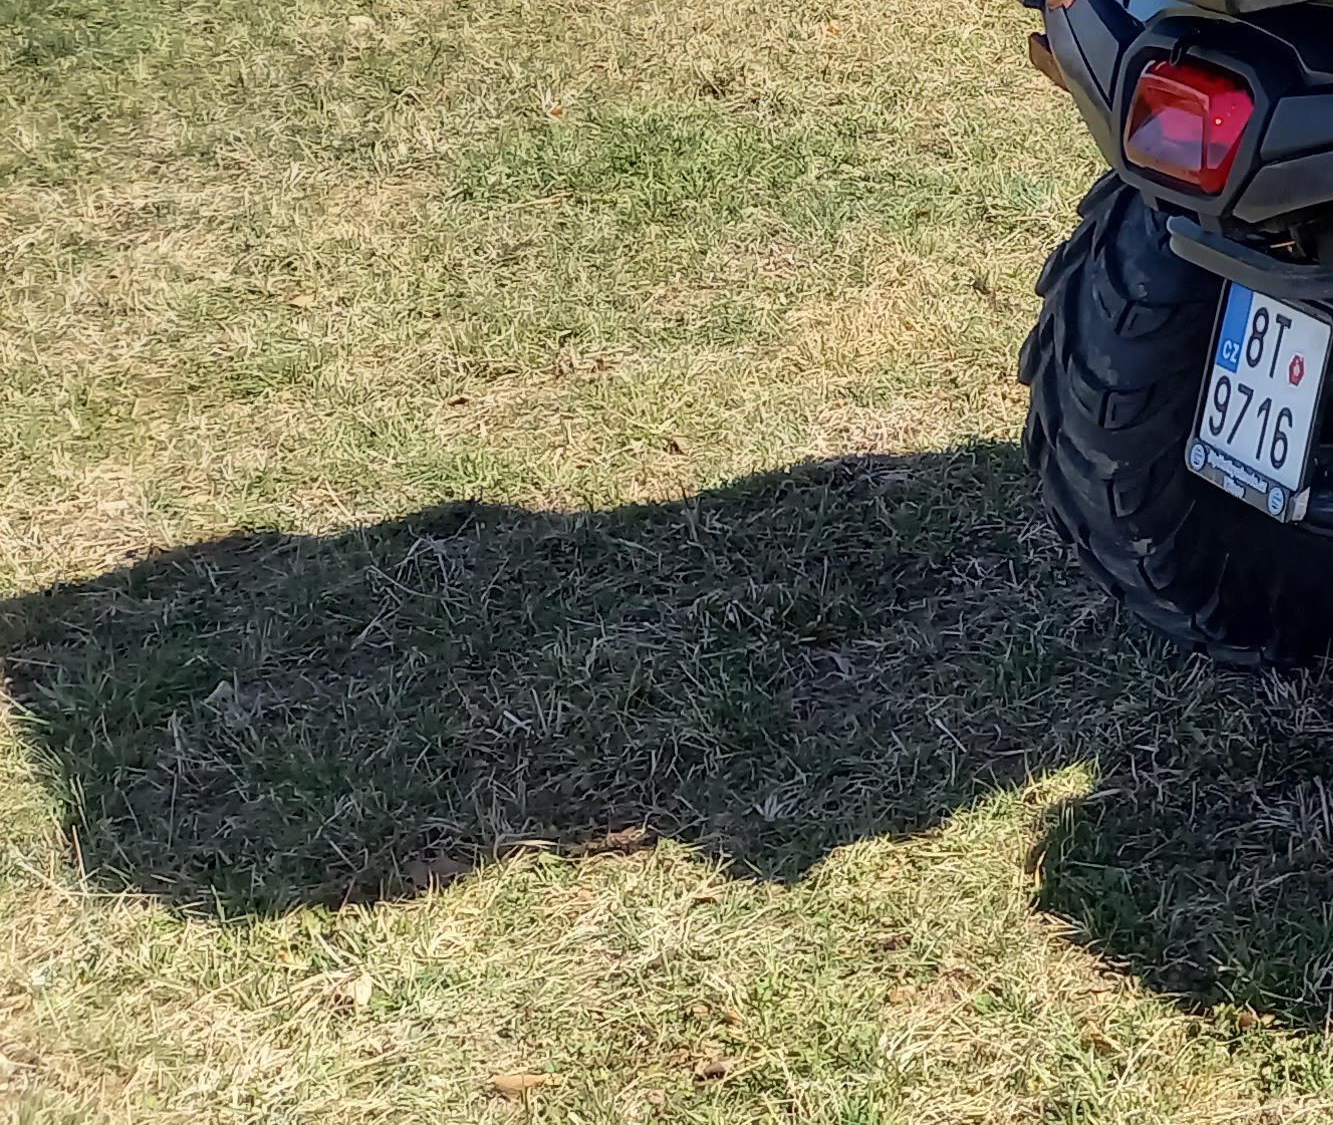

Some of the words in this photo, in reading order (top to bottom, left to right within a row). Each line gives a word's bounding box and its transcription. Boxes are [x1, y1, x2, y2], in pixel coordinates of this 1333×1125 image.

[1222, 339, 1240, 364] CZ
[1246, 306, 1293, 379] 8T
[1208, 375, 1293, 470] 9716
